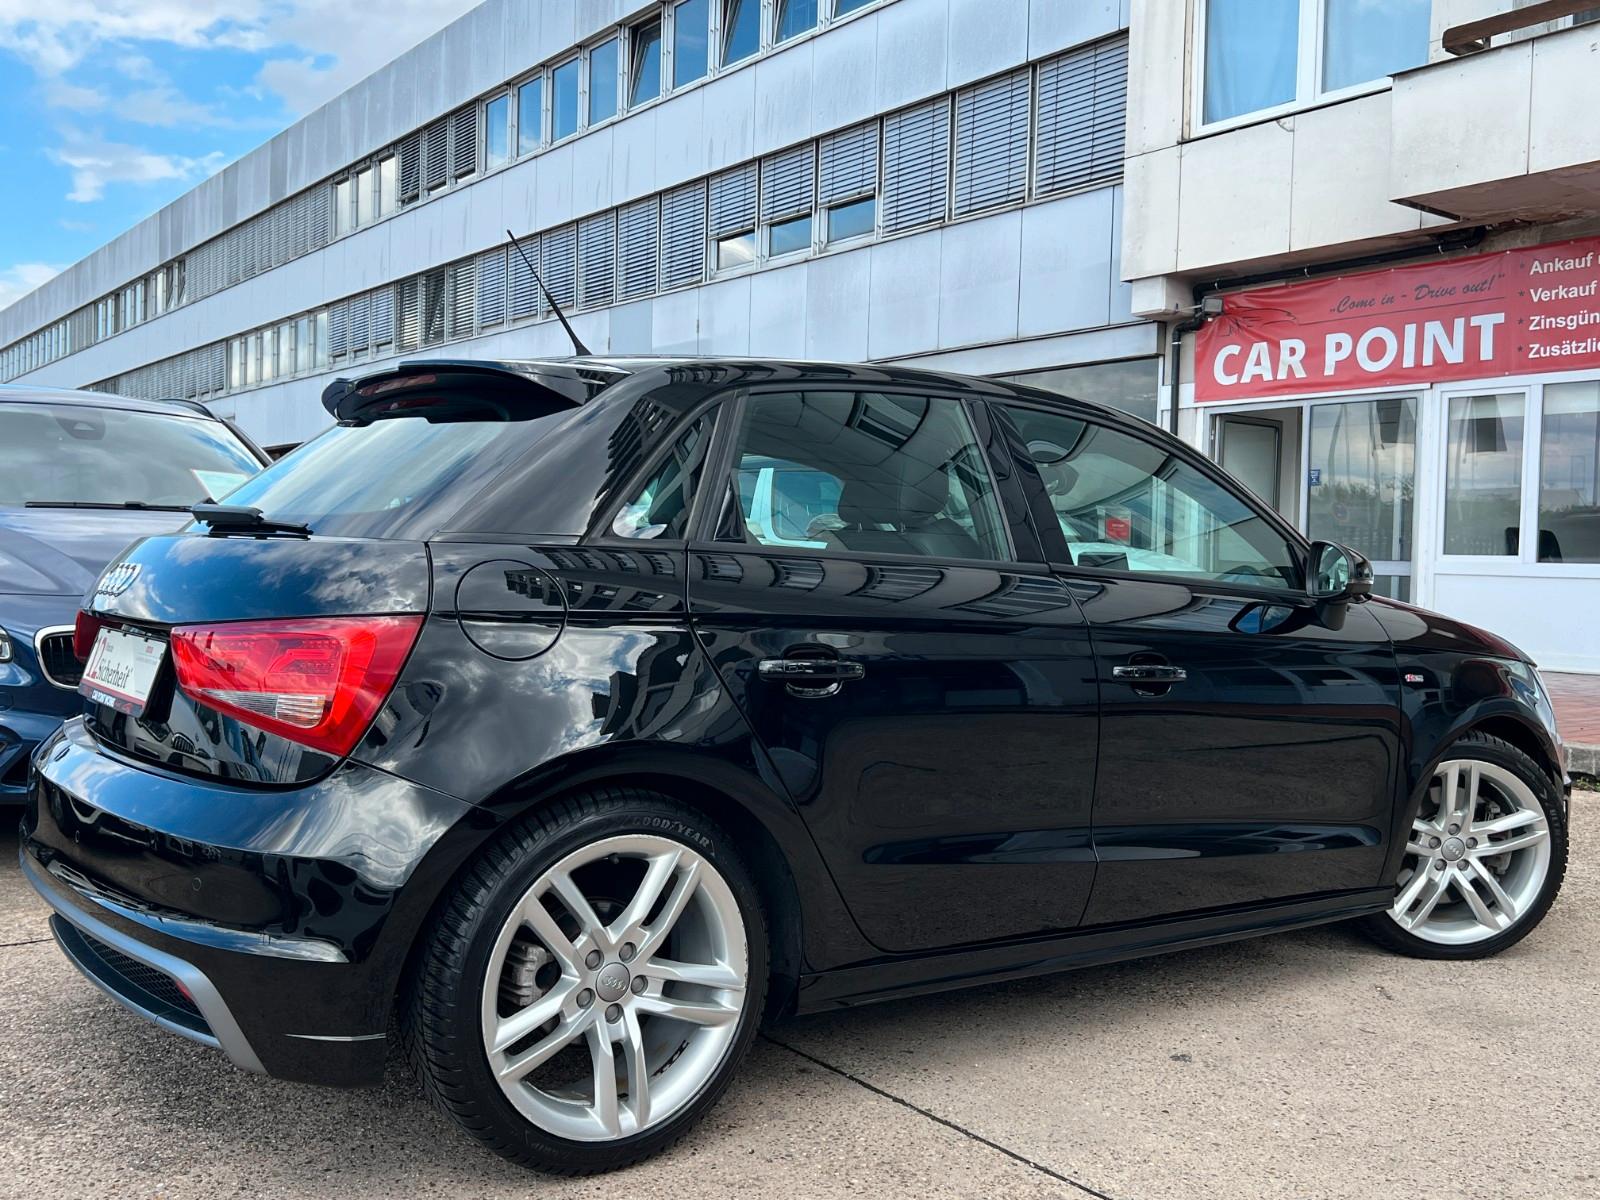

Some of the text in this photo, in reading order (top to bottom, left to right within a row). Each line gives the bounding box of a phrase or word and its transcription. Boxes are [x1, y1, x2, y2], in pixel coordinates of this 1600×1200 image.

[1529, 252, 1594, 275] Ankauf
[1381, 294, 1394, 304] in
[1414, 283, 1456, 301] Drive
[1529, 280, 1598, 302] Verkauf
[1528, 310, 1600, 331] Zinsgün
[1213, 312, 1505, 386] CAR POINT
